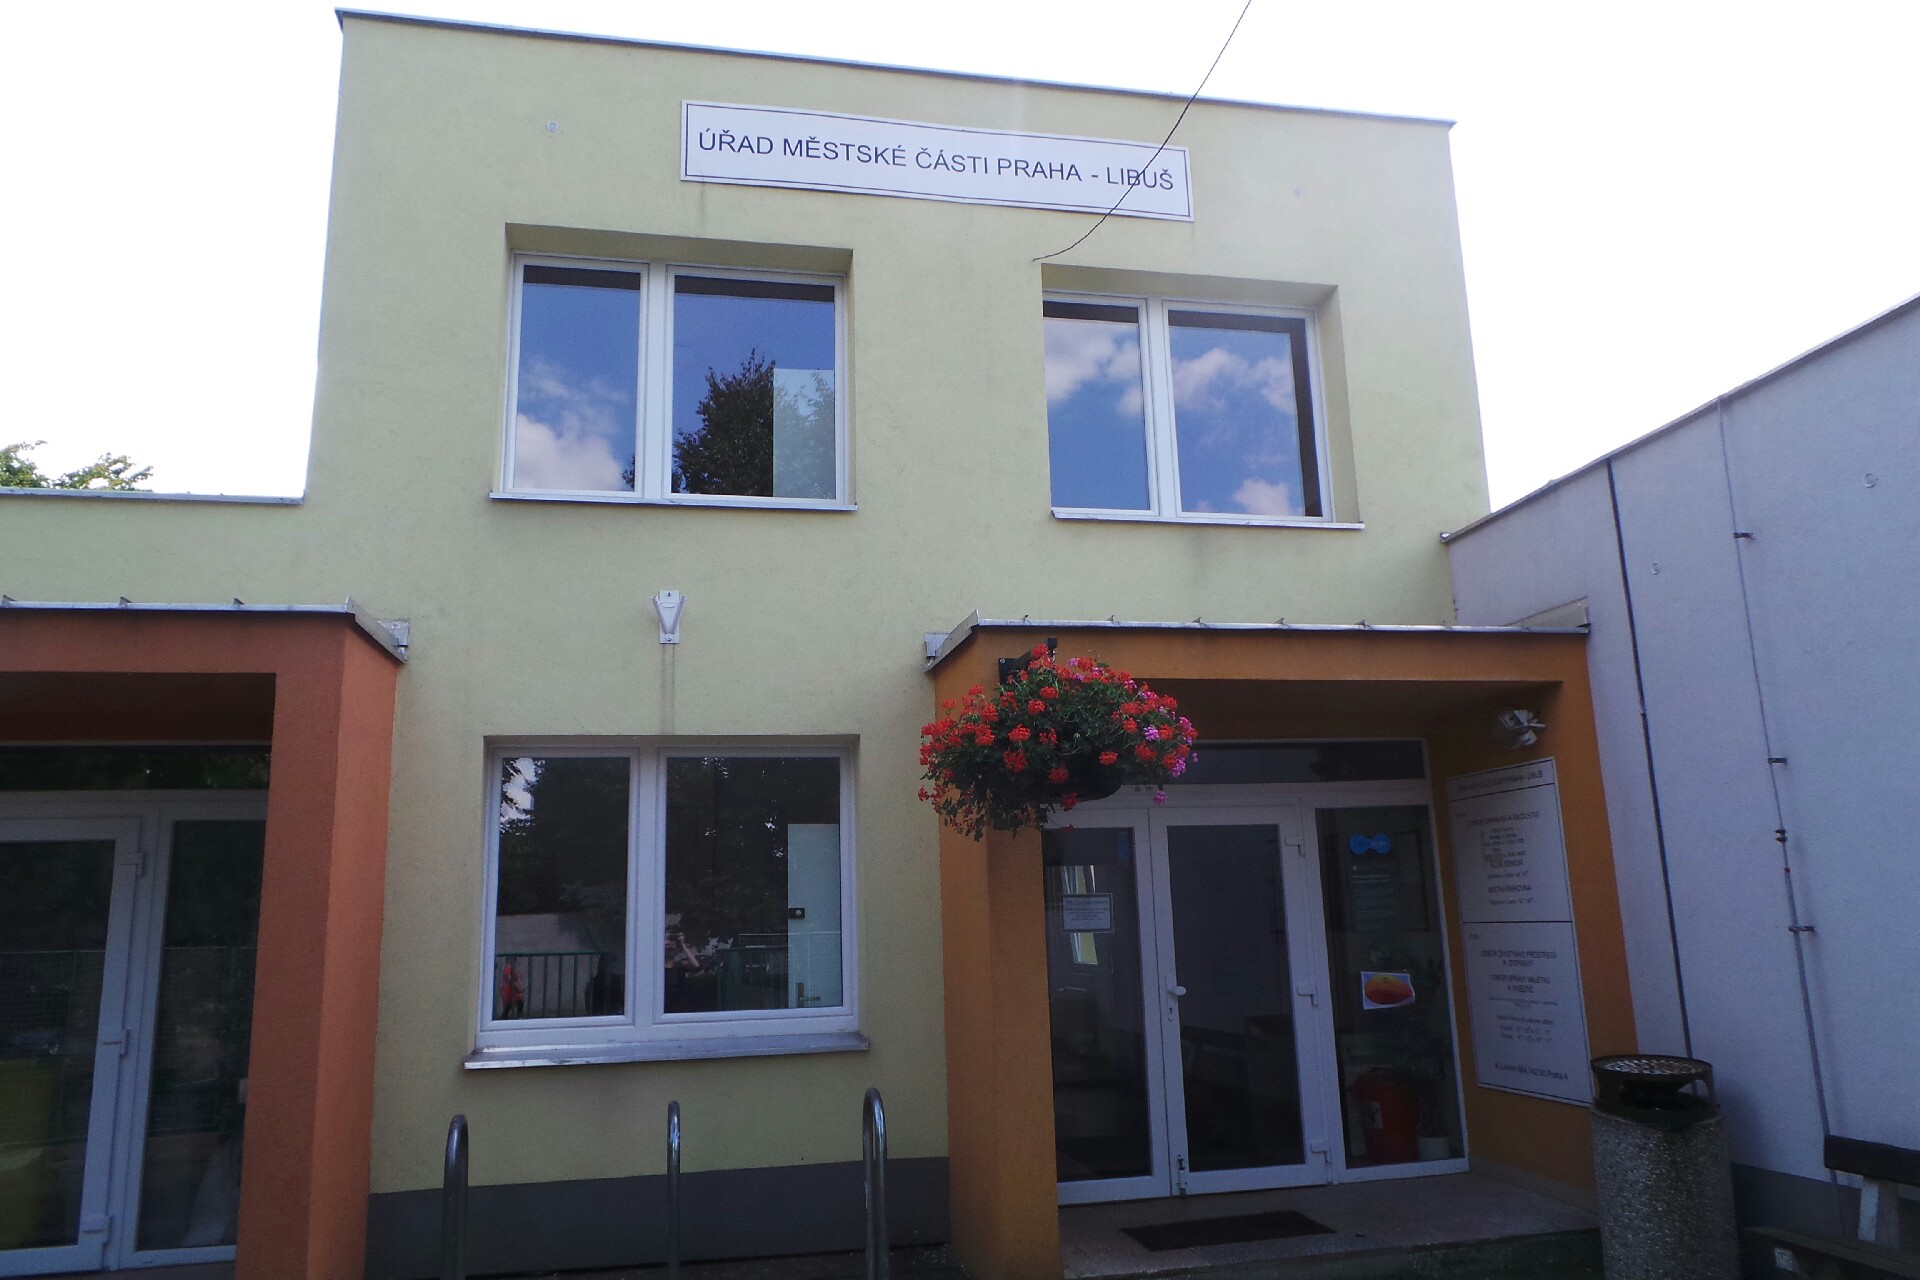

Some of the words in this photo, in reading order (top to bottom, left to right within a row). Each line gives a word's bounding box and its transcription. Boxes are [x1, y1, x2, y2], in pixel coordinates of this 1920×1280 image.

[698, 128, 774, 155] ÚŘAD
[783, 136, 907, 167] MĚSTSKÉ
[915, 147, 989, 175] ČÁSTI
[997, 157, 1082, 182] PRAHA
[1106, 166, 1174, 191] LIBUŠ
